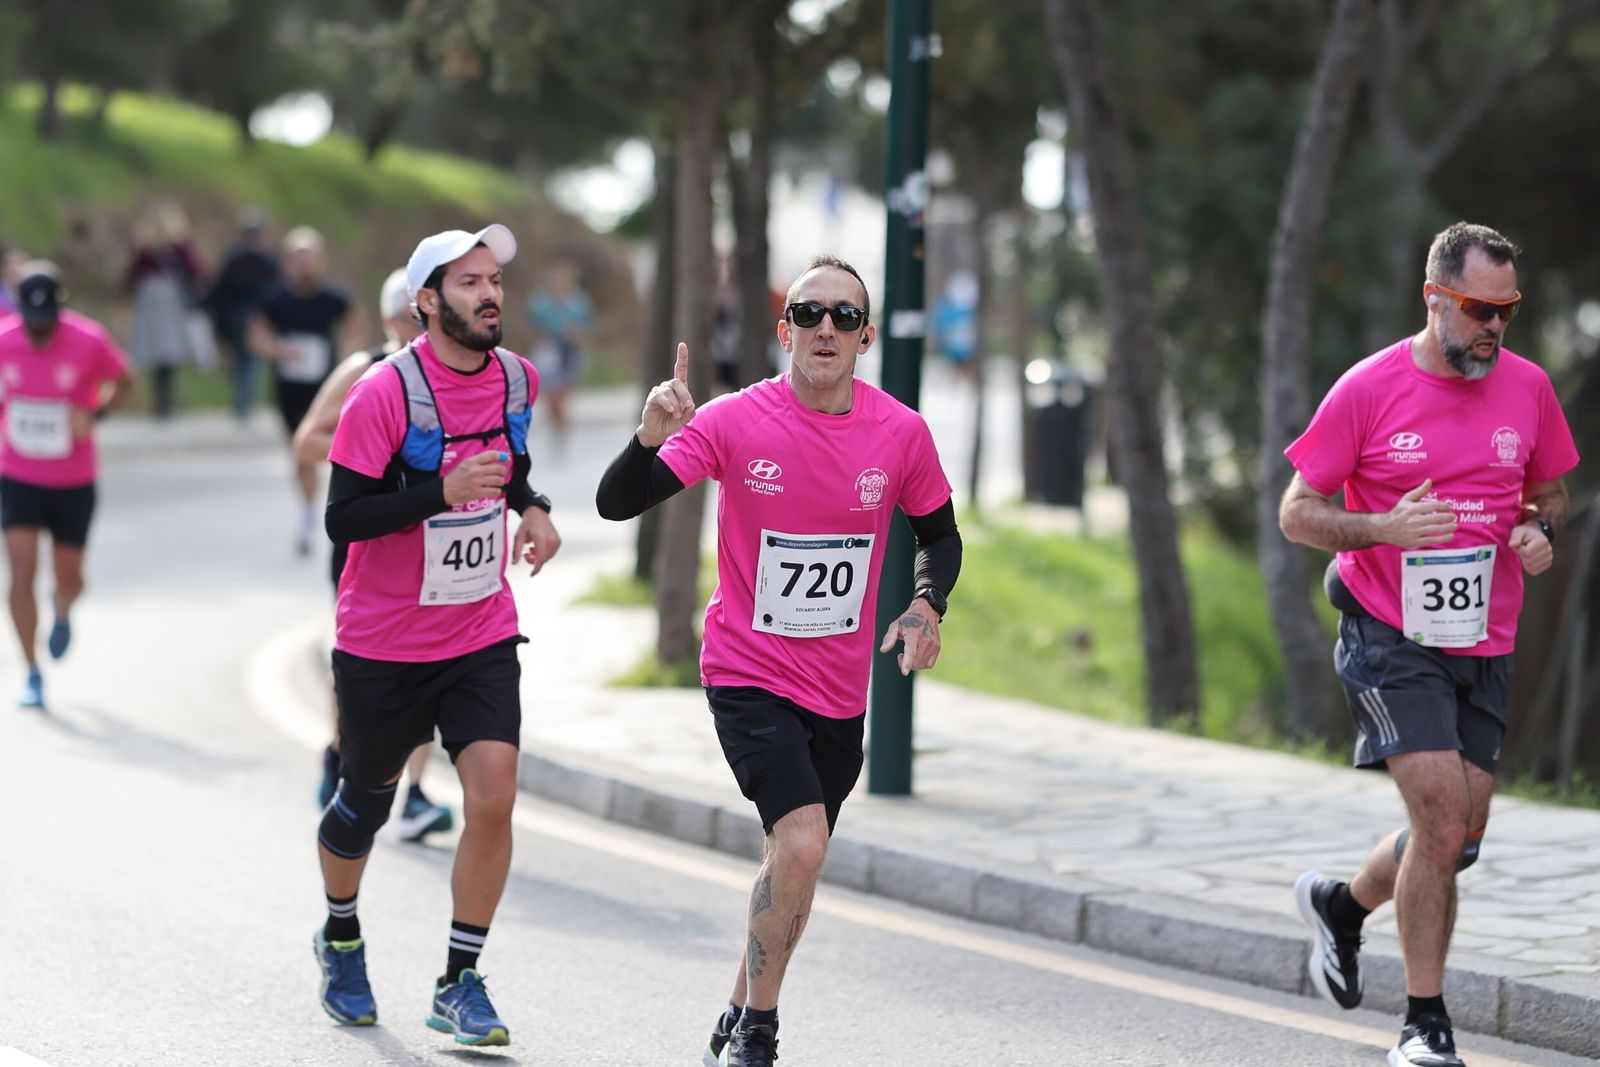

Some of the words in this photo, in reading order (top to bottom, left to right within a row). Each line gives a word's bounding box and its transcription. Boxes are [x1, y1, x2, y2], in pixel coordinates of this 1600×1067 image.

[1387, 451, 1428, 460] HYUNDAI
[744, 478, 784, 493] HYUNDAI
[1445, 499, 1485, 511] Ciudad
[1459, 512, 1497, 525] Málaga
[442, 531, 496, 572] 401
[780, 561, 854, 599] 720
[1422, 574, 1485, 612] 381
